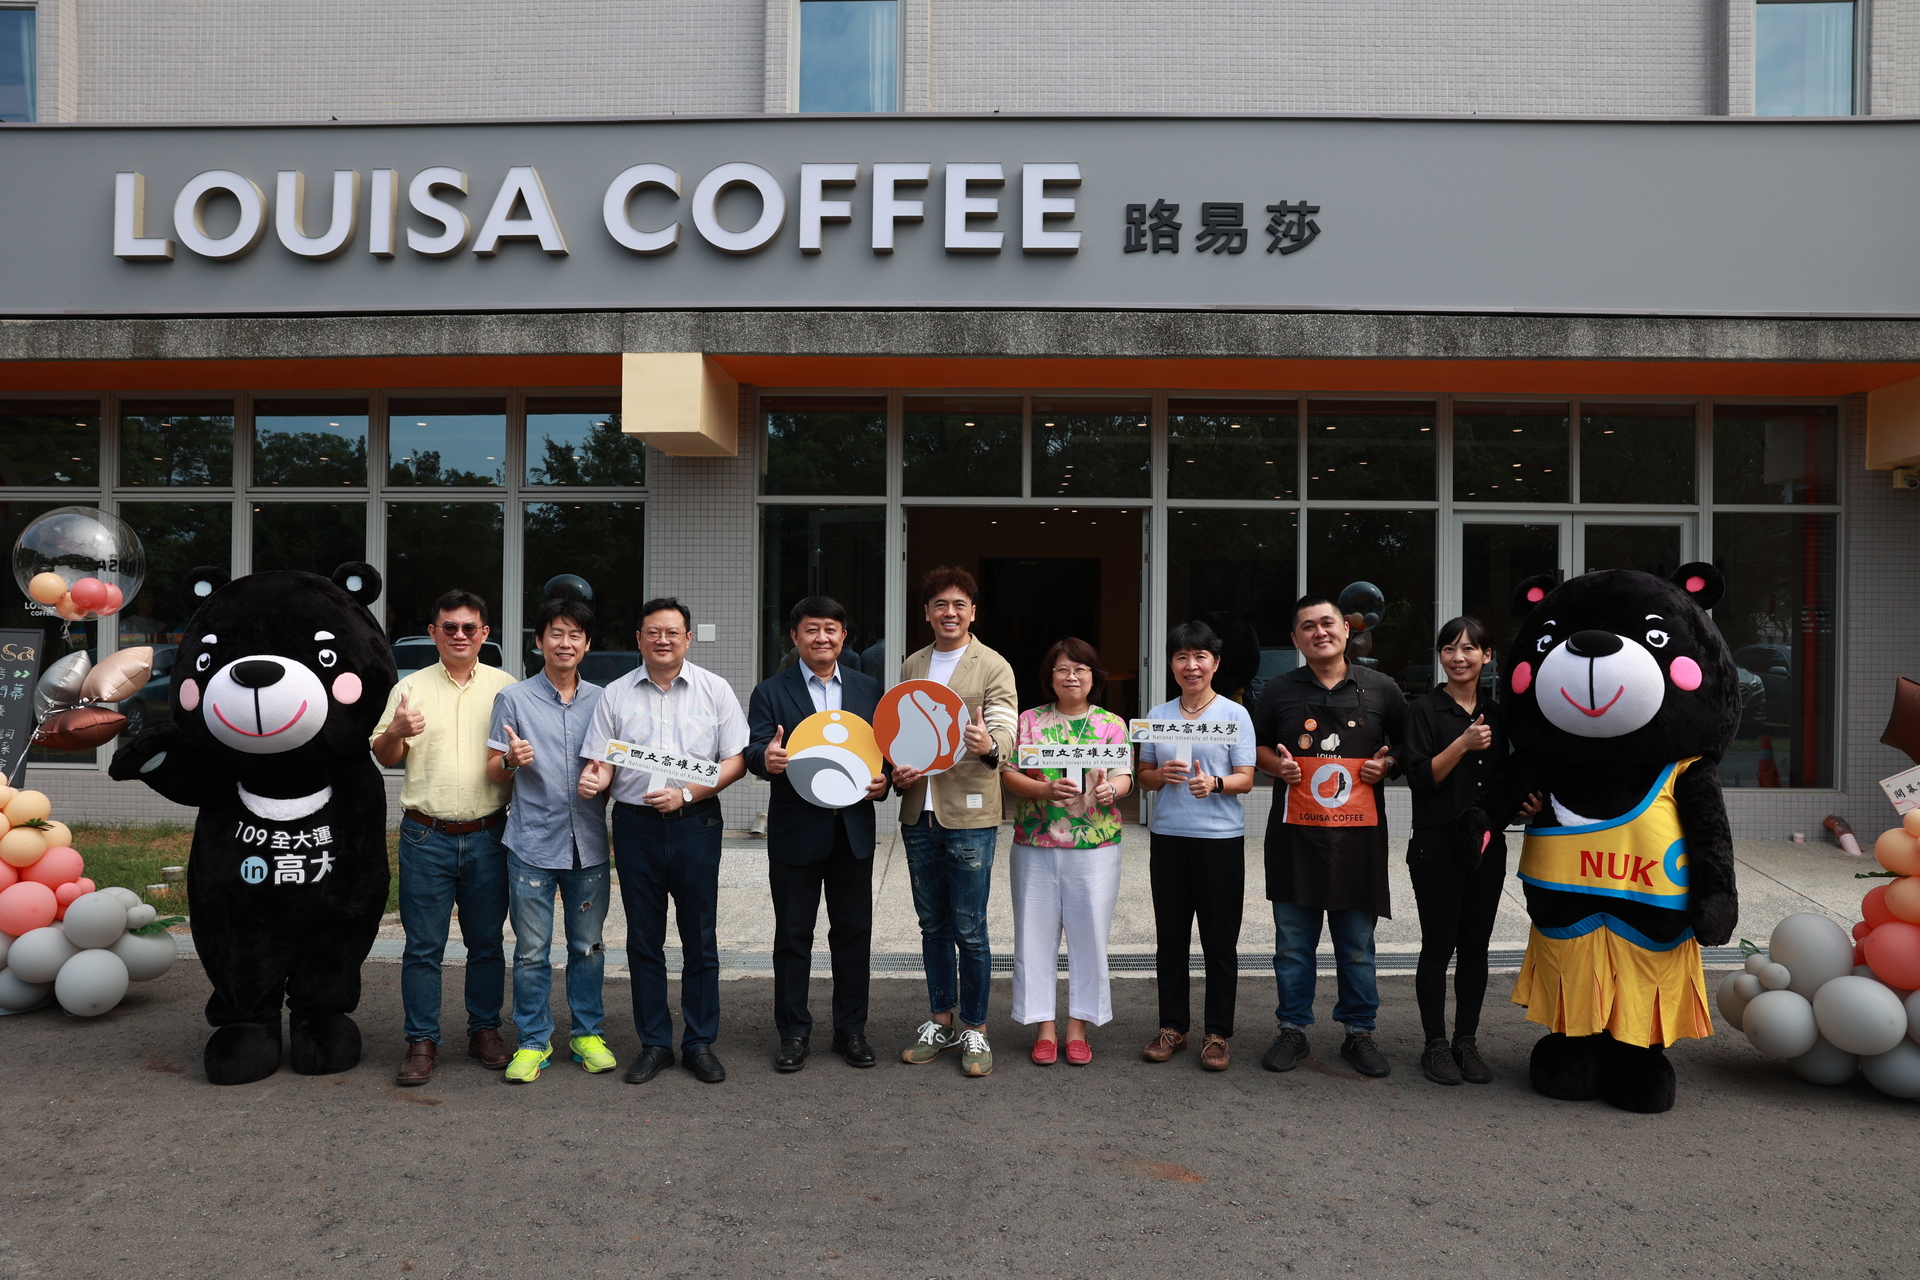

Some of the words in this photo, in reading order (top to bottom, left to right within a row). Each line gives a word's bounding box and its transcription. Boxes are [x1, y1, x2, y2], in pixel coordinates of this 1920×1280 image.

[113, 165, 569, 258] LOUISA
[602, 161, 1083, 254] COFFEE
[1123, 198, 1322, 255] 路易莎
[1151, 722, 1238, 736] 國立高雄大學
[1175, 734, 1201, 742] University
[1209, 735, 1238, 743] Kaohsiung
[630, 748, 719, 777] 國立高雄大學
[1041, 746, 1128, 759] 國立高雄大學
[627, 759, 651, 770] National
[651, 765, 680, 777] University
[687, 773, 715, 785] Kaohsiung
[1300, 813, 1331, 822] LOUISA
[1333, 814, 1364, 822] COFFEE
[274, 851, 336, 885] 高大
[1580, 850, 1659, 887] NUK
